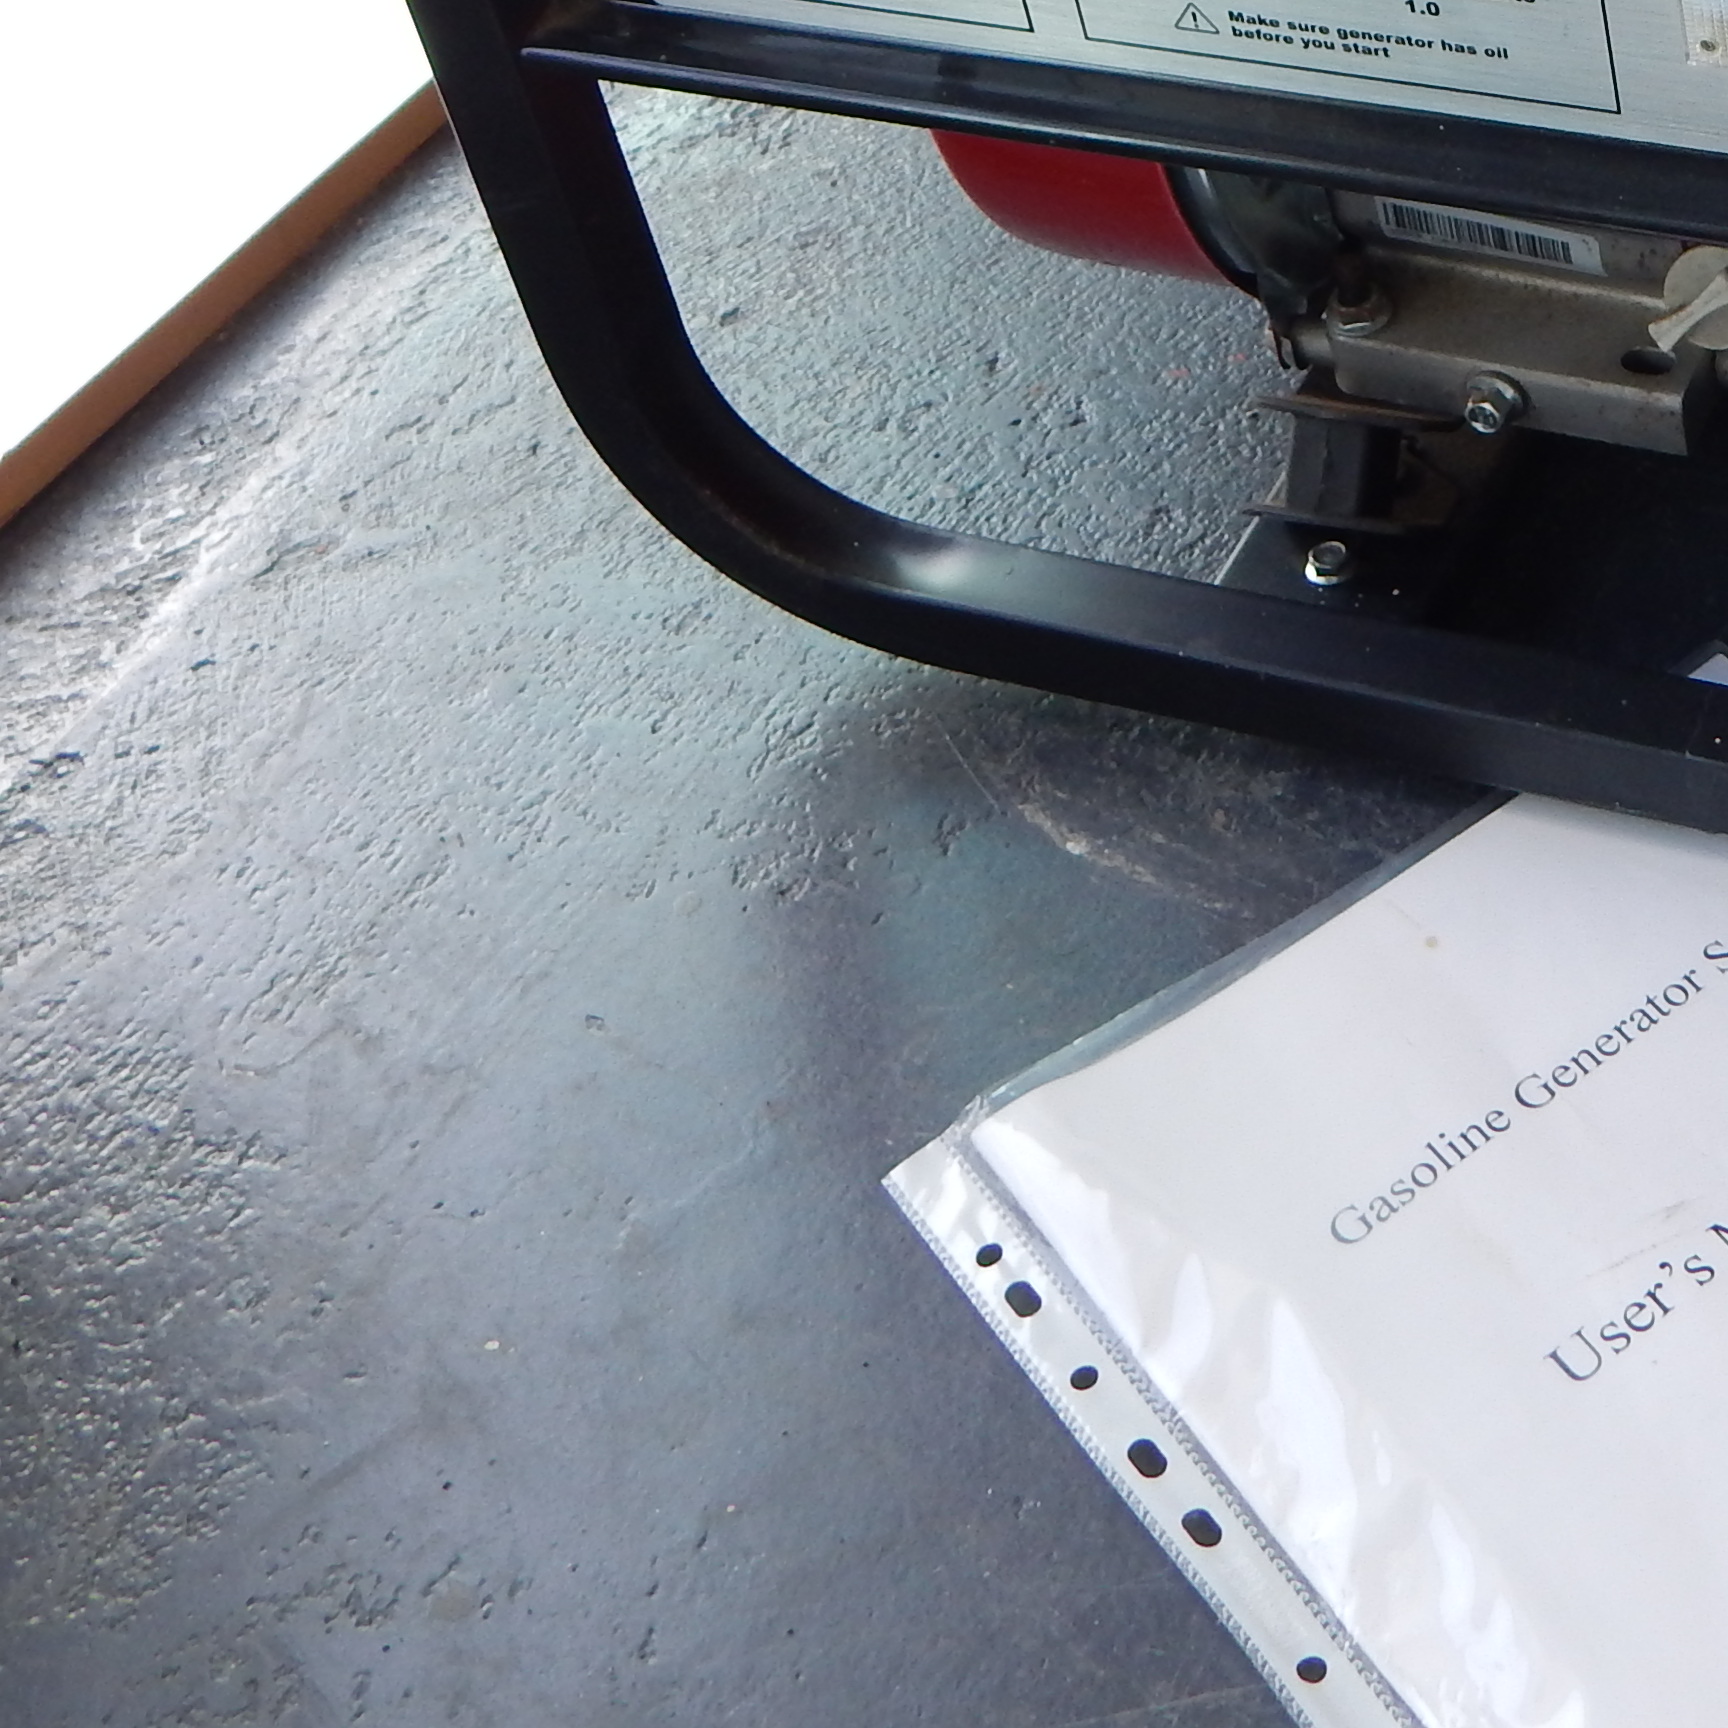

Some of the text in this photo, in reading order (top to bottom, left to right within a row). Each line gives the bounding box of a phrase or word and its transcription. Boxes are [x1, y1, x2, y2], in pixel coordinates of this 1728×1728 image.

[1404, 0, 1440, 17] 1.0
[1227, 10, 1509, 60] Make sure generator has oil
[1231, 26, 1392, 59] before you start
[1330, 1107, 1512, 1246] Gasoline
[1513, 968, 1704, 1110] Generator
